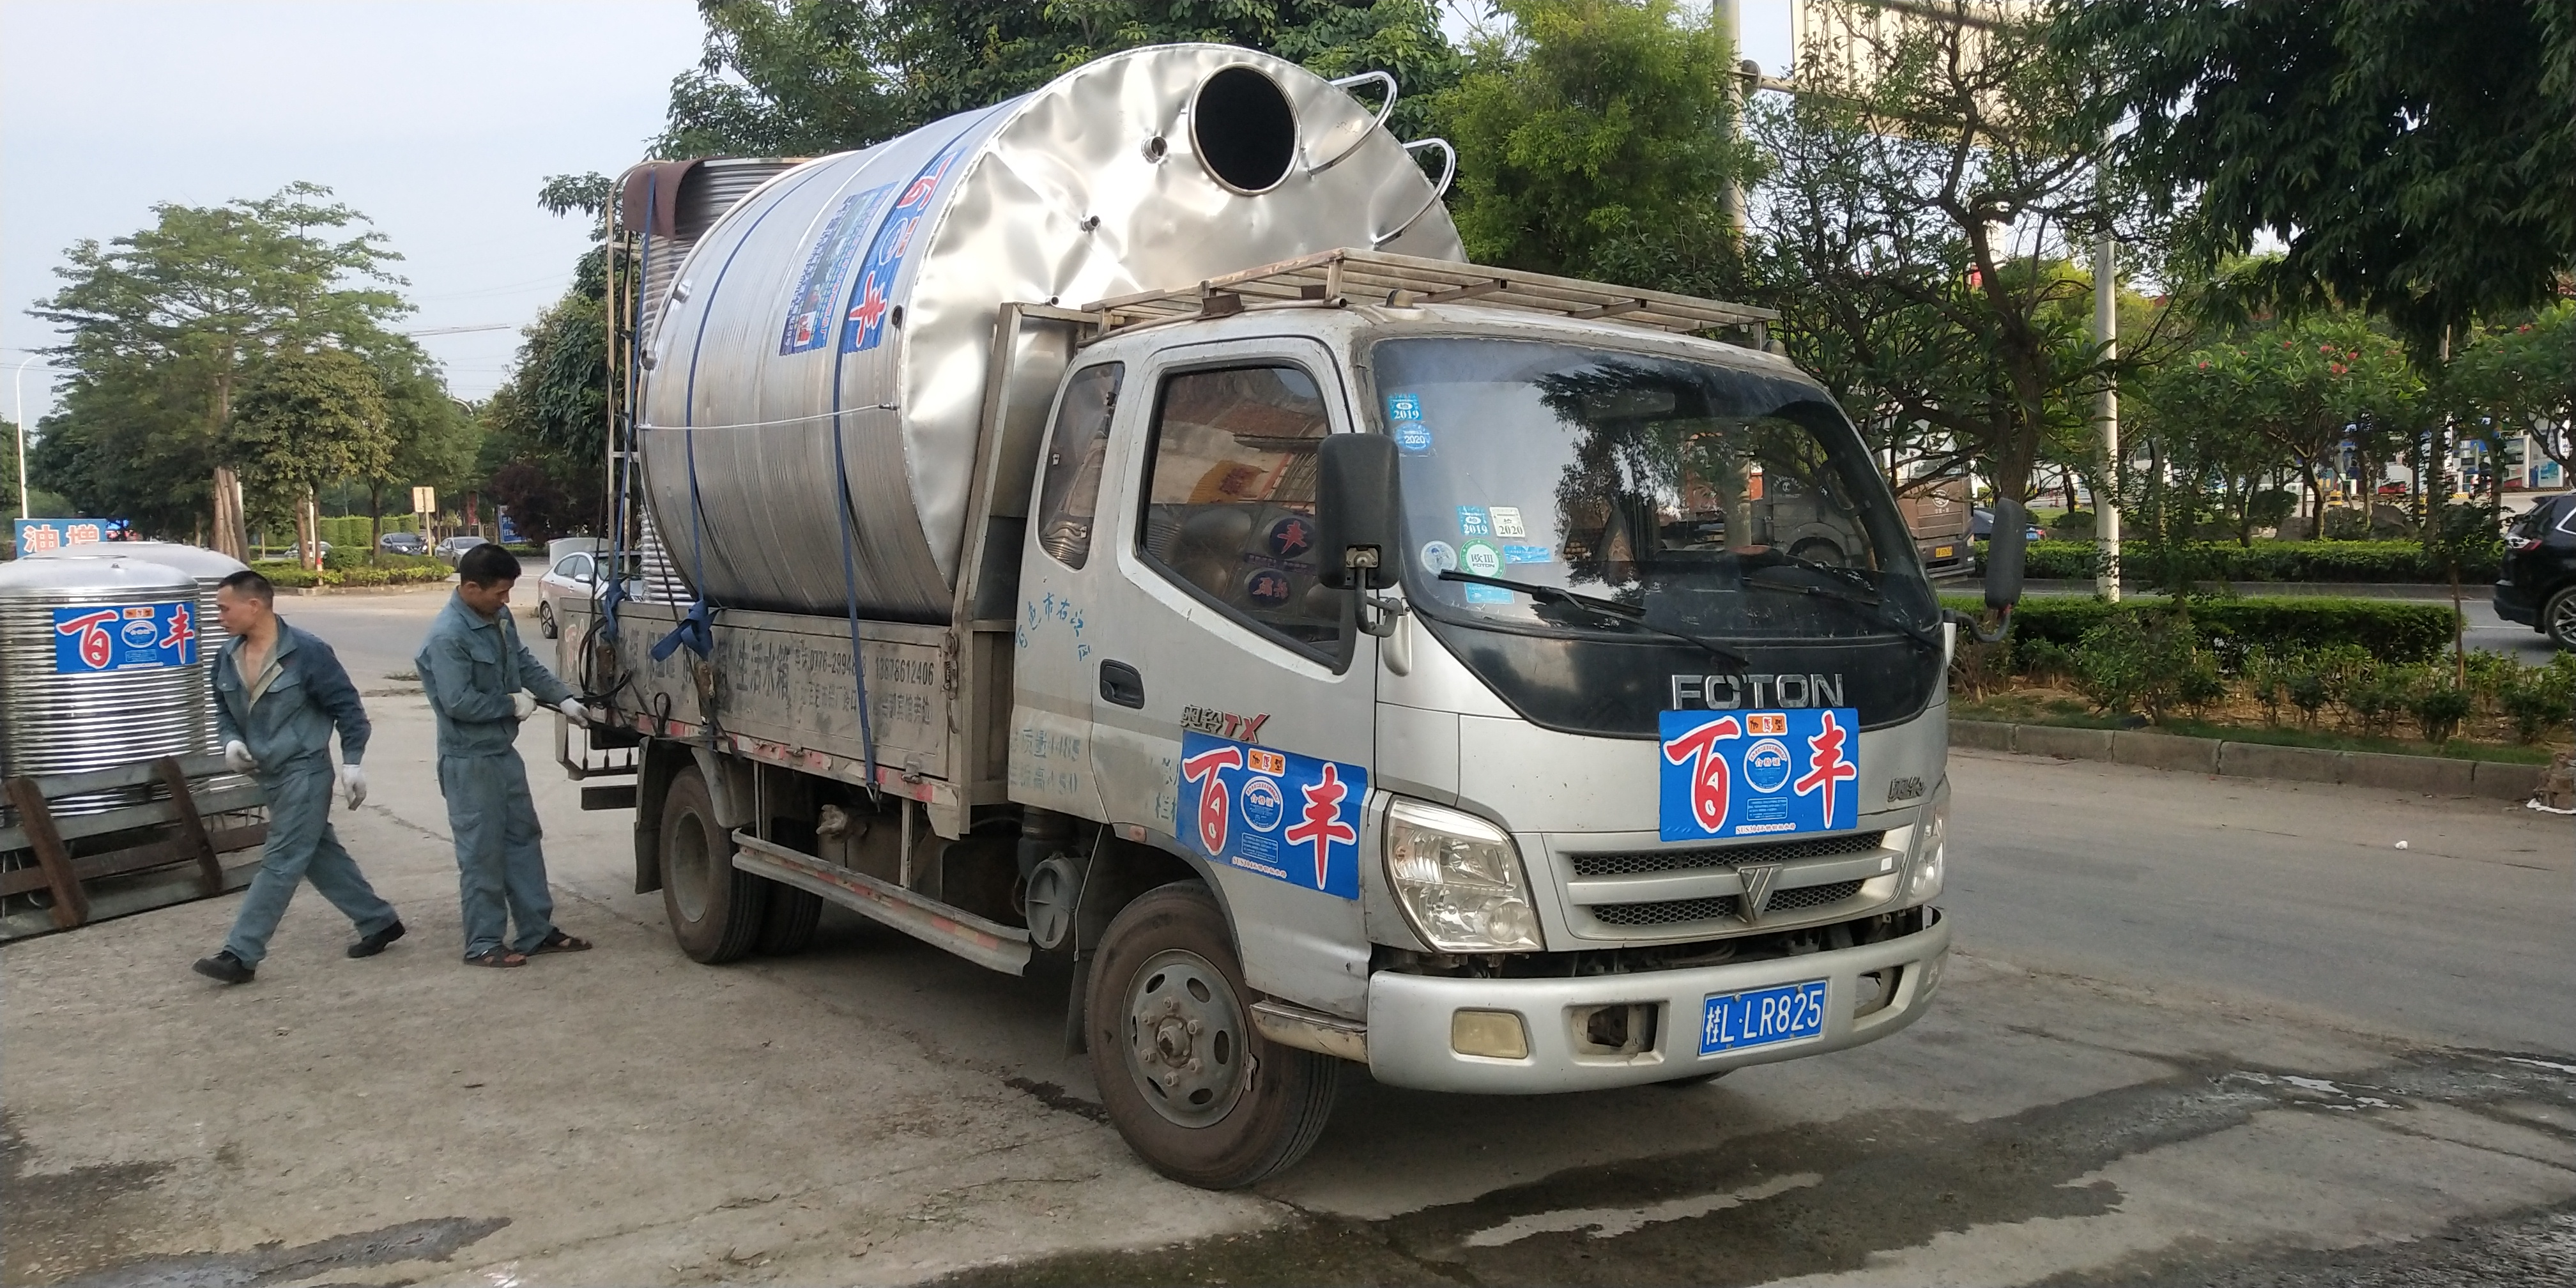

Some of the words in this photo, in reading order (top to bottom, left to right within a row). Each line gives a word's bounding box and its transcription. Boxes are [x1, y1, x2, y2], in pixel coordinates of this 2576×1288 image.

[1393, 410, 1420, 420] 2019
[1404, 436, 1425, 444] 2020
[1464, 524, 1488, 534] 2019
[1499, 526, 1523, 535] 2020
[56, 610, 119, 669] 百
[159, 604, 194, 664] 丰
[875, 656, 935, 686] 13878612406
[1671, 673, 1844, 711] FOTON
[1663, 715, 1742, 833] 百
[1793, 710, 1857, 829] 丰
[1182, 745, 1243, 856] 百
[1285, 762, 1357, 891] 丰
